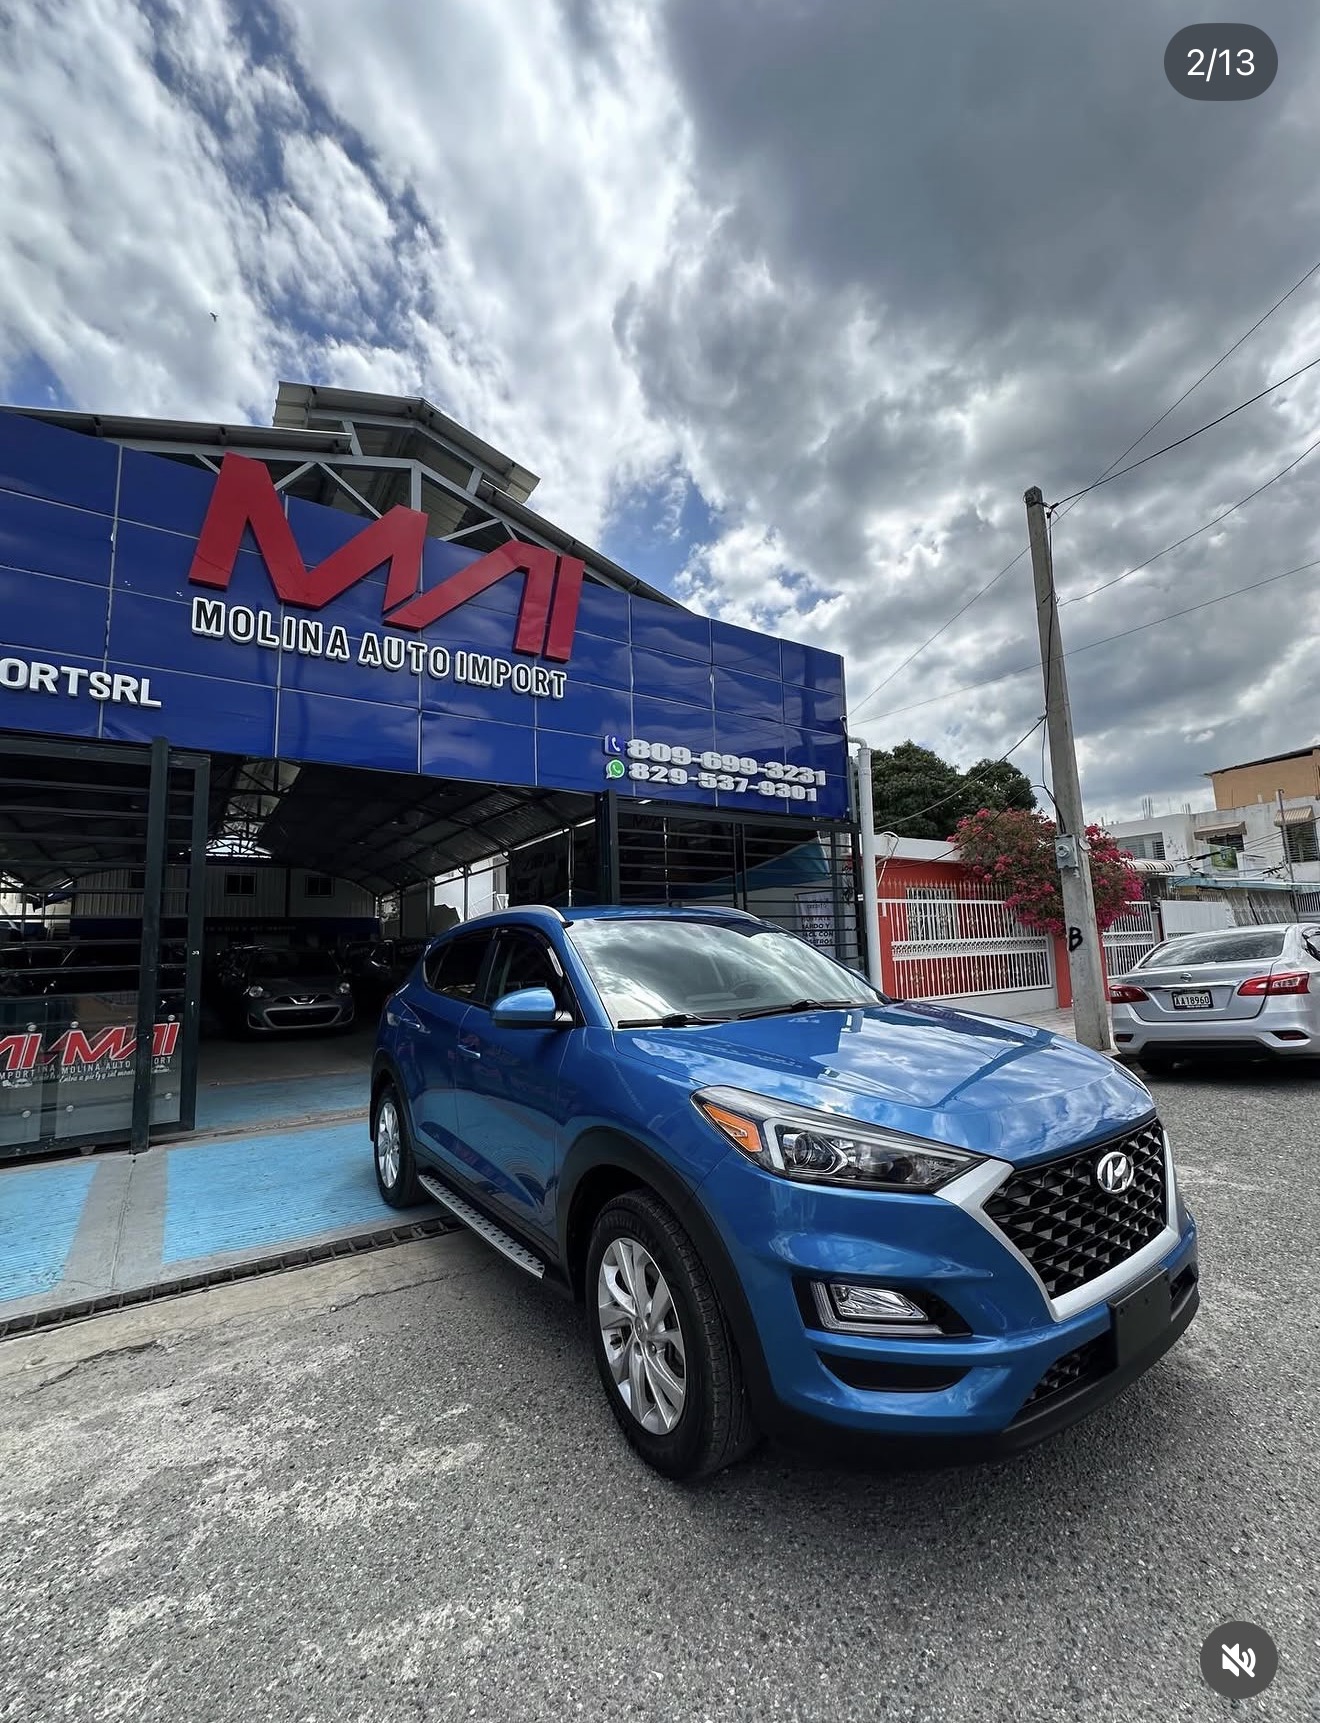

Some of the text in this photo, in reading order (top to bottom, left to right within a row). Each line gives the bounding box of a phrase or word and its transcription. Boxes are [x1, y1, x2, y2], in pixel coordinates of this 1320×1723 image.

[191, 597, 567, 700] MOLINA AUTO IMPORT
[626, 738, 827, 787] 809-699-3231
[628, 762, 818, 802] 829-537-9301
[1069, 926, 1083, 953] B
[61, 1063, 100, 1075] MOLINA
[105, 1060, 131, 1070] AUTO
